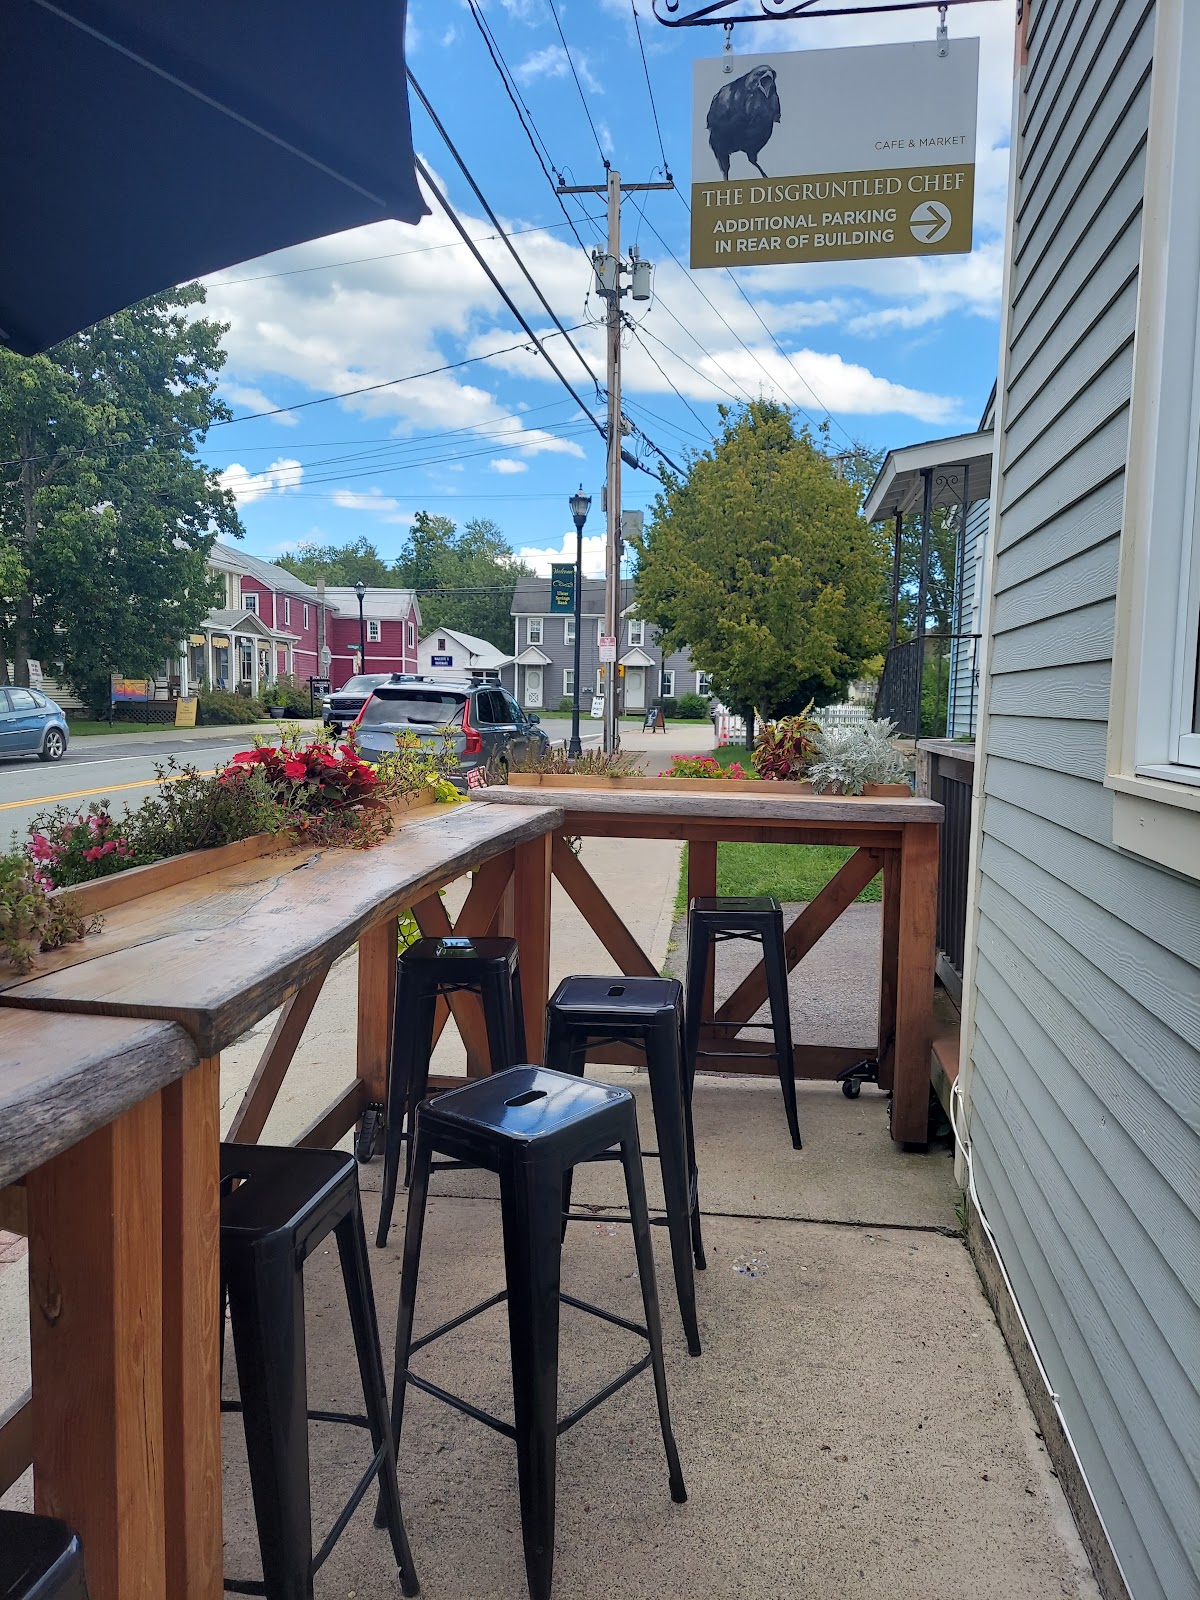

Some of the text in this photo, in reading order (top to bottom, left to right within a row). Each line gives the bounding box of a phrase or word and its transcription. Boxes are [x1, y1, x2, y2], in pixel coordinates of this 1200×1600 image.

[874, 135, 966, 151] CAFE & MARKET
[701, 172, 965, 207] THE DISGRUNTLED CHEF
[712, 208, 897, 234] ADDITIONAL PARKING
[715, 229, 895, 253] IN REAR OF BUILDING
